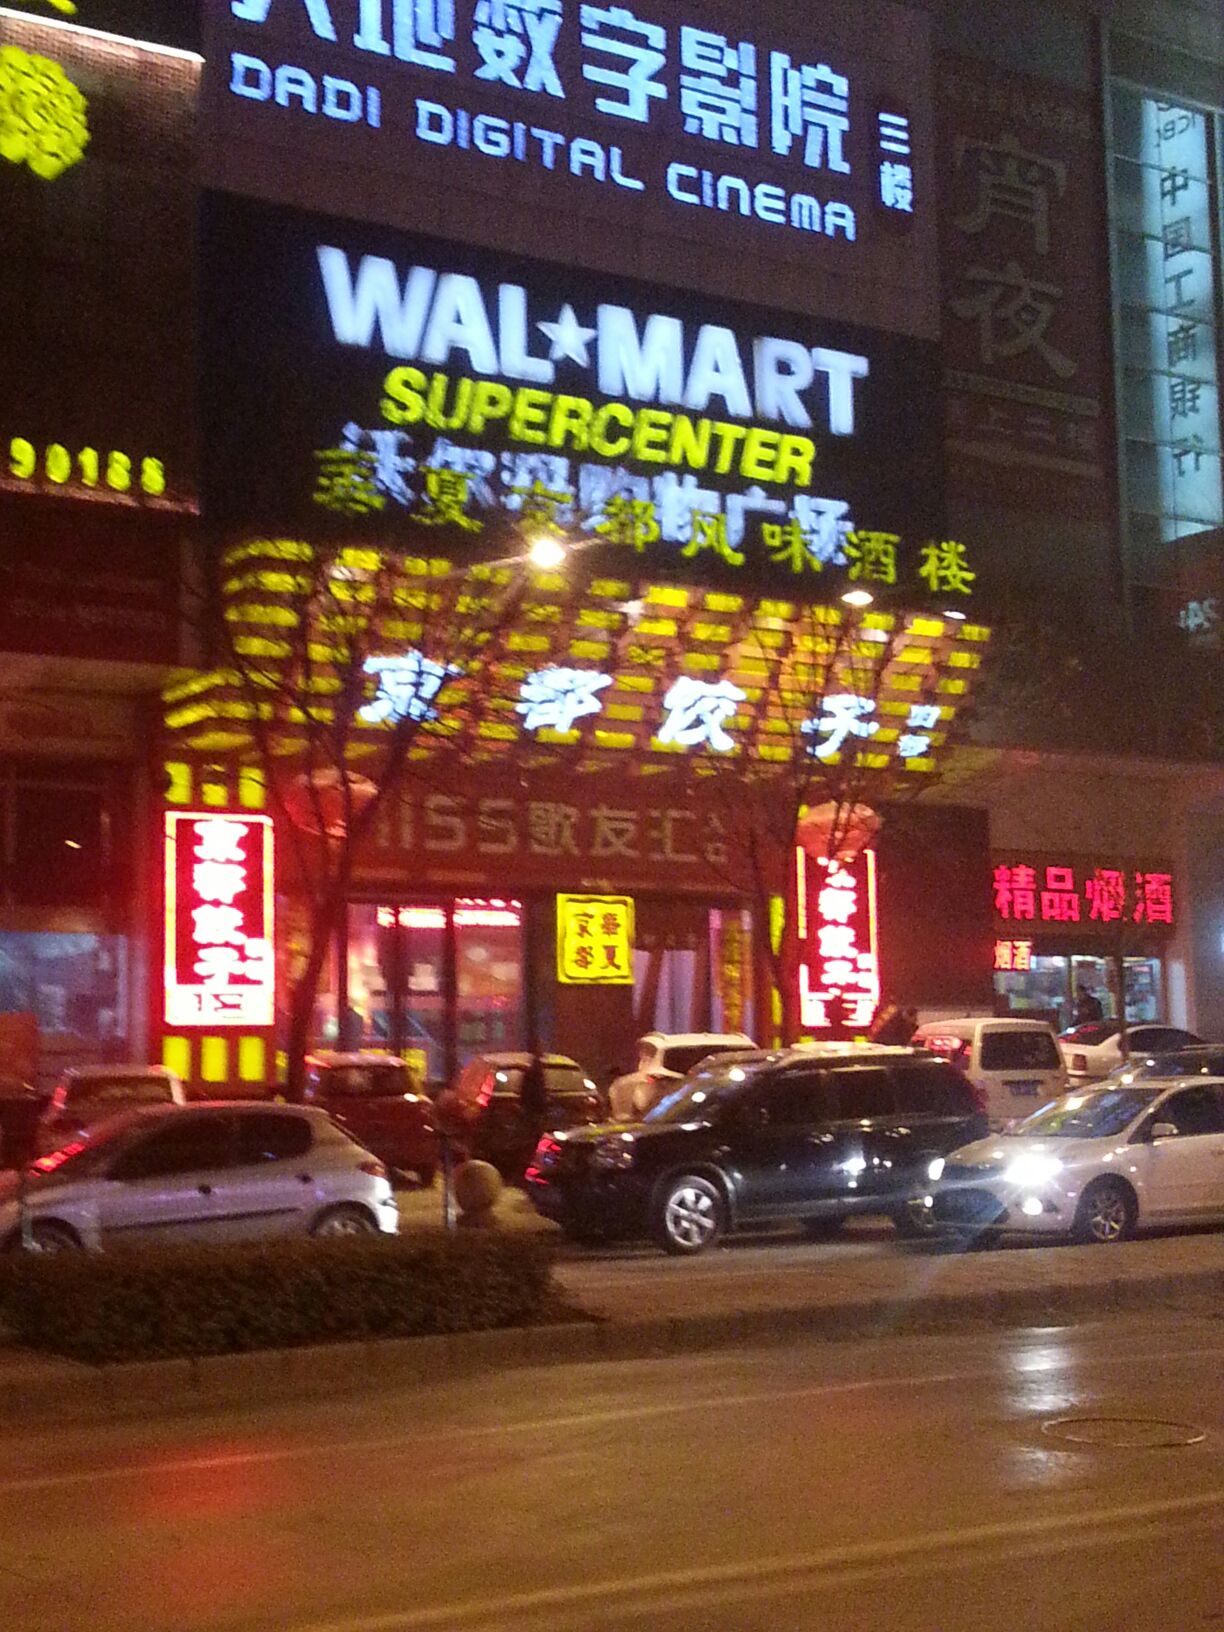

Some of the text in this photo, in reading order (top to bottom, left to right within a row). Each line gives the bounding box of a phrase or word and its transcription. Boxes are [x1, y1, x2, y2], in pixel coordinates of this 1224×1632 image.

[229, 52, 856, 241] DADI DIGITAL CINEMA
[380, 366, 816, 487] SUPERCENTER
